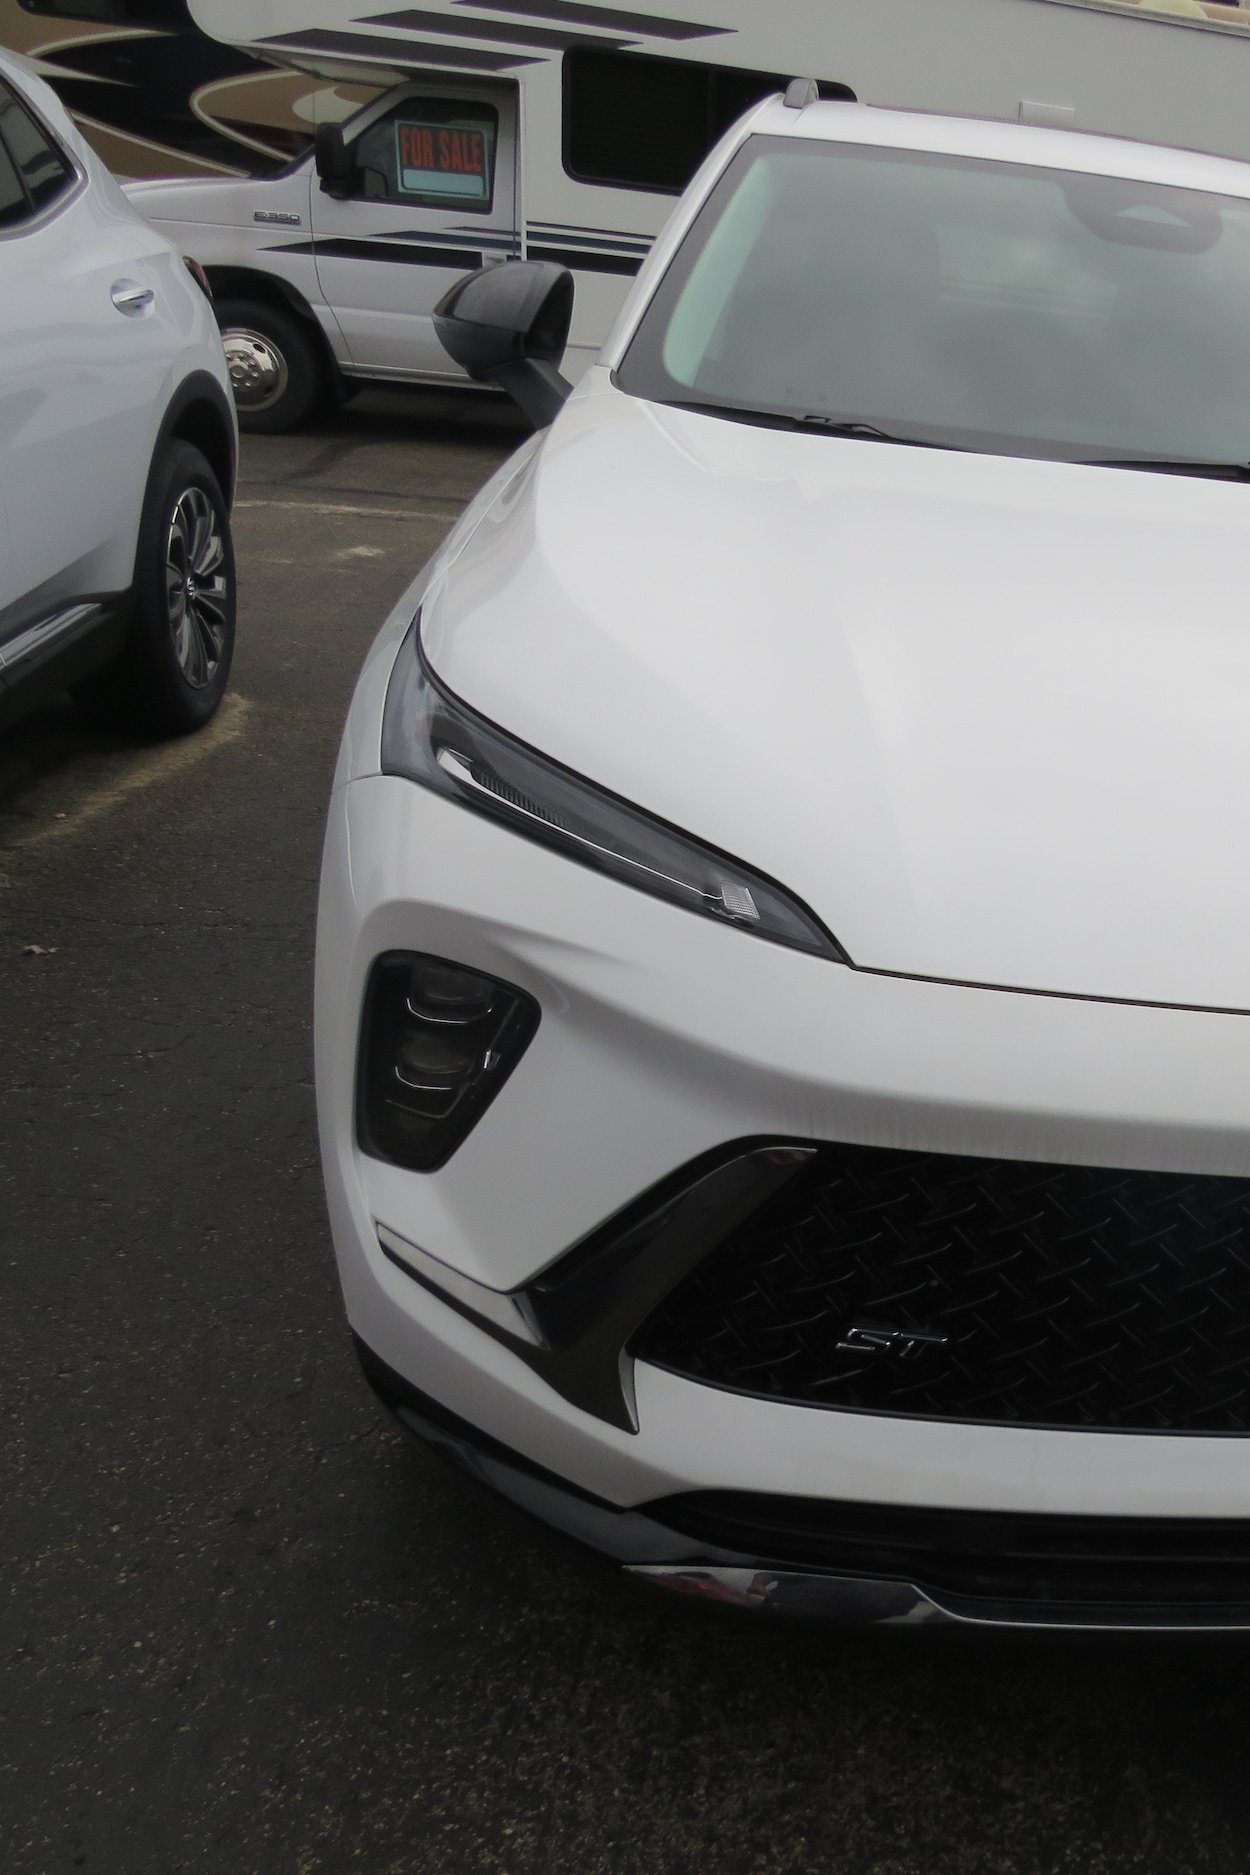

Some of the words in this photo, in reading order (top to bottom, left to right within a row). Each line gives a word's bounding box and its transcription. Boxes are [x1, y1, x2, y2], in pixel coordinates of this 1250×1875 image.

[401, 126, 434, 168] FOR
[440, 128, 483, 173] SALE
[835, 1326, 948, 1359] ST
